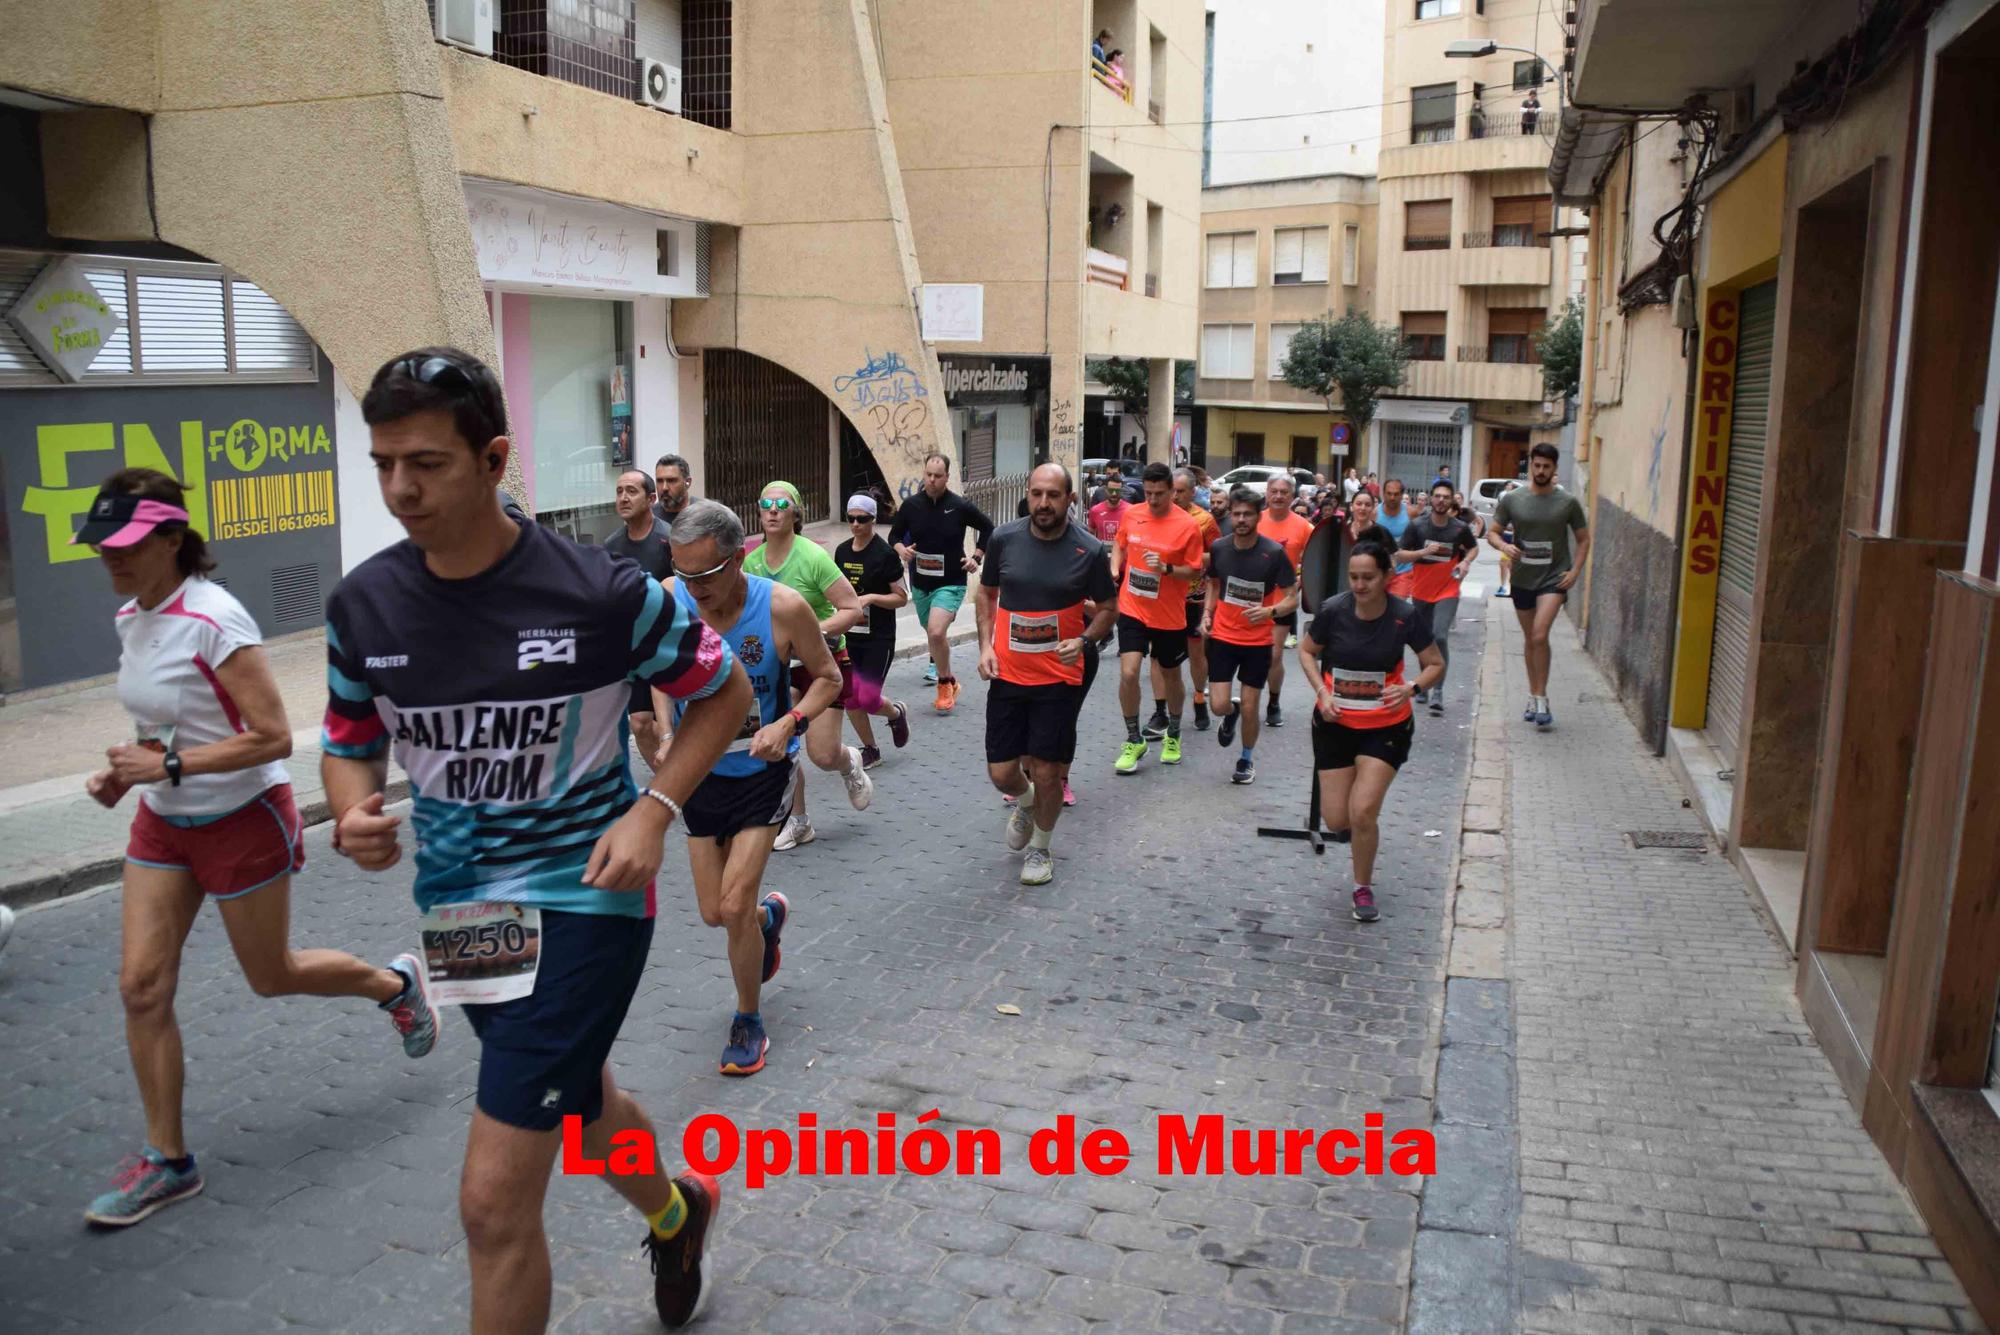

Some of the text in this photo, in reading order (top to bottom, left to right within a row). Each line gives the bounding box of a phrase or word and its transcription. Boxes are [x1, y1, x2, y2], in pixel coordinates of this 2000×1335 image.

[1690, 301, 1736, 575] CORTINAS
[223, 513, 328, 539] DESDE 061096
[518, 628, 576, 639] HERBALIFE
[365, 655, 409, 668] FASTER
[517, 639, 576, 671] 24
[393, 702, 566, 752] HALLENGE
[446, 754, 545, 803] ROOM
[433, 922, 526, 961] 1250
